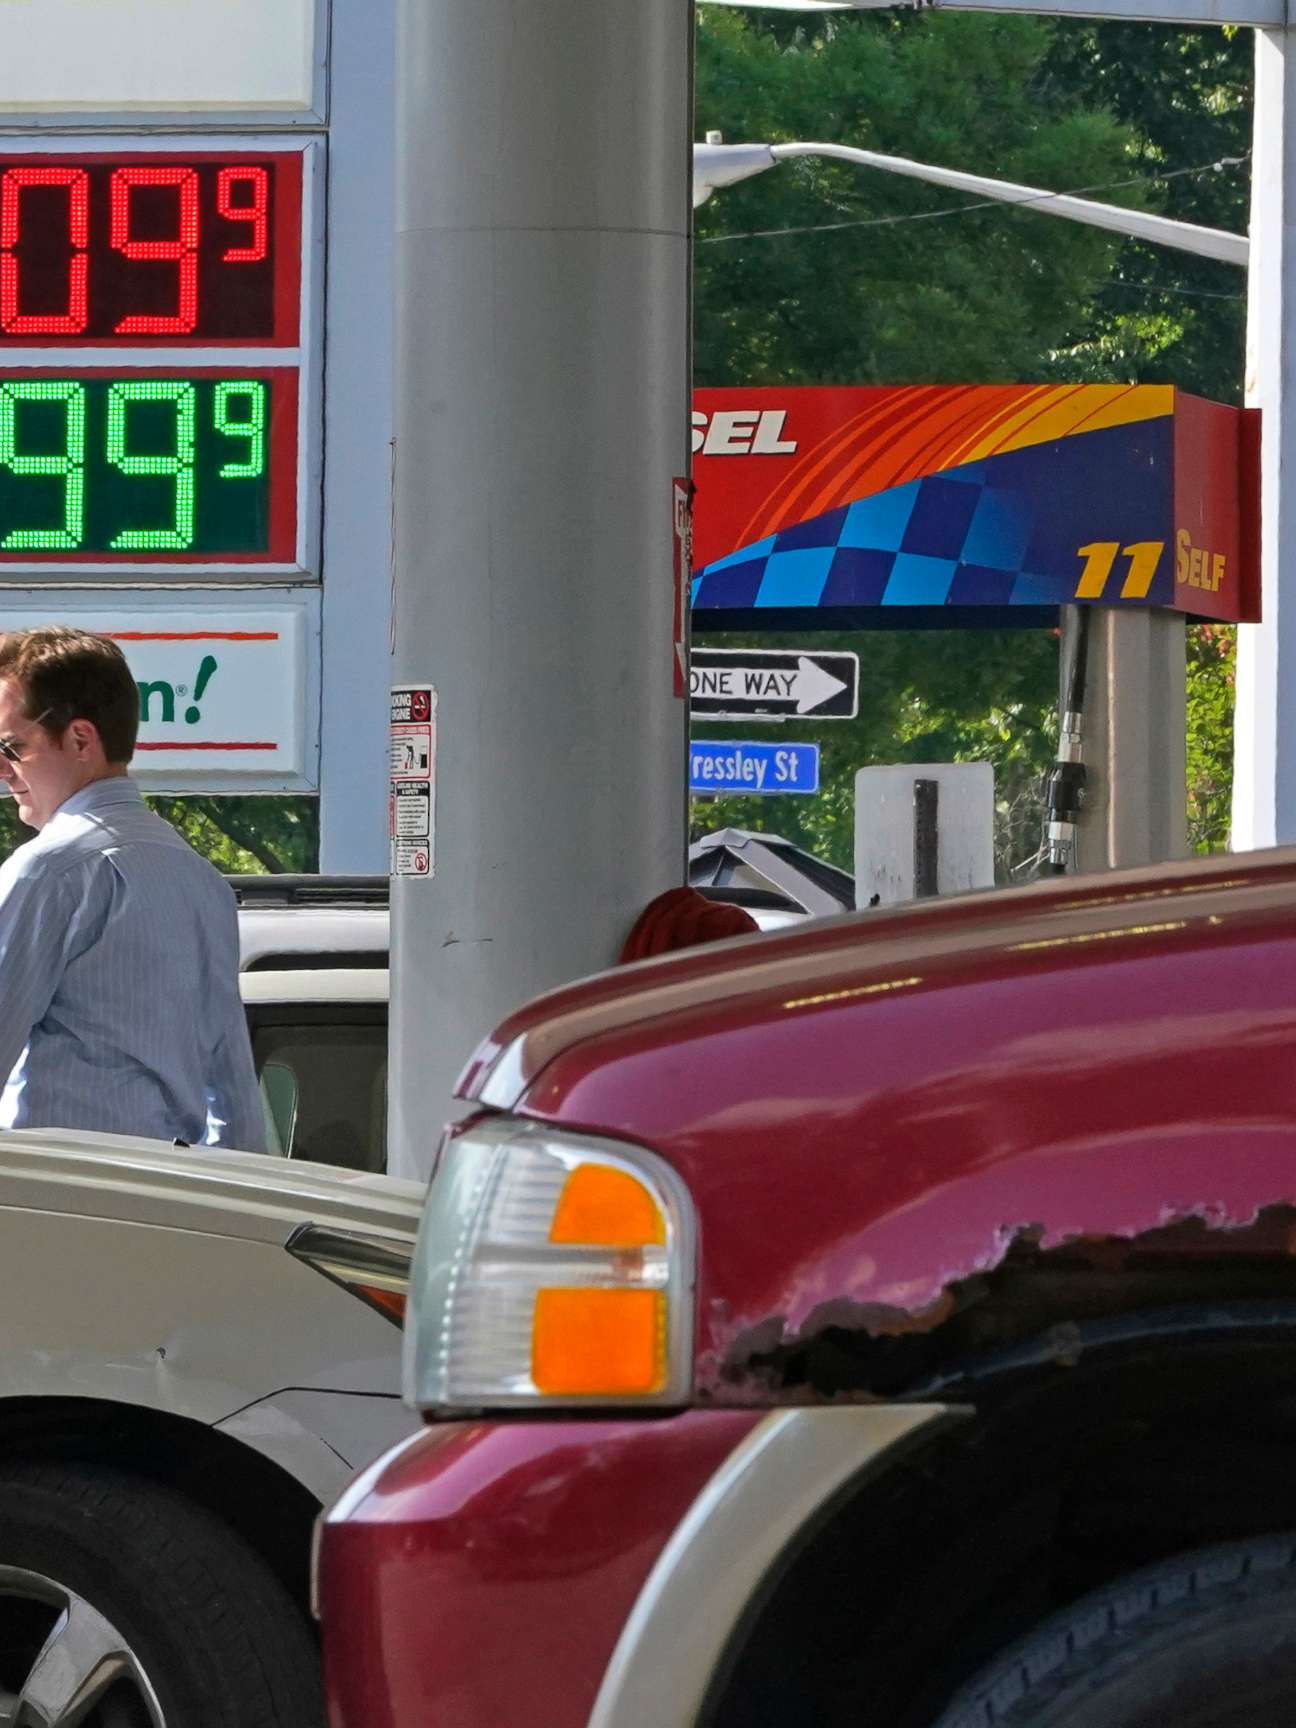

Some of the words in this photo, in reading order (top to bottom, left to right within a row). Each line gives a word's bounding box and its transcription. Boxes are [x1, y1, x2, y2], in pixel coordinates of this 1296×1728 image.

[1074, 541, 1165, 598] 11
[1176, 527, 1225, 592] SELF
[744, 672, 798, 697] WAY
[691, 750, 768, 789] ressley
[774, 750, 799, 783] St
